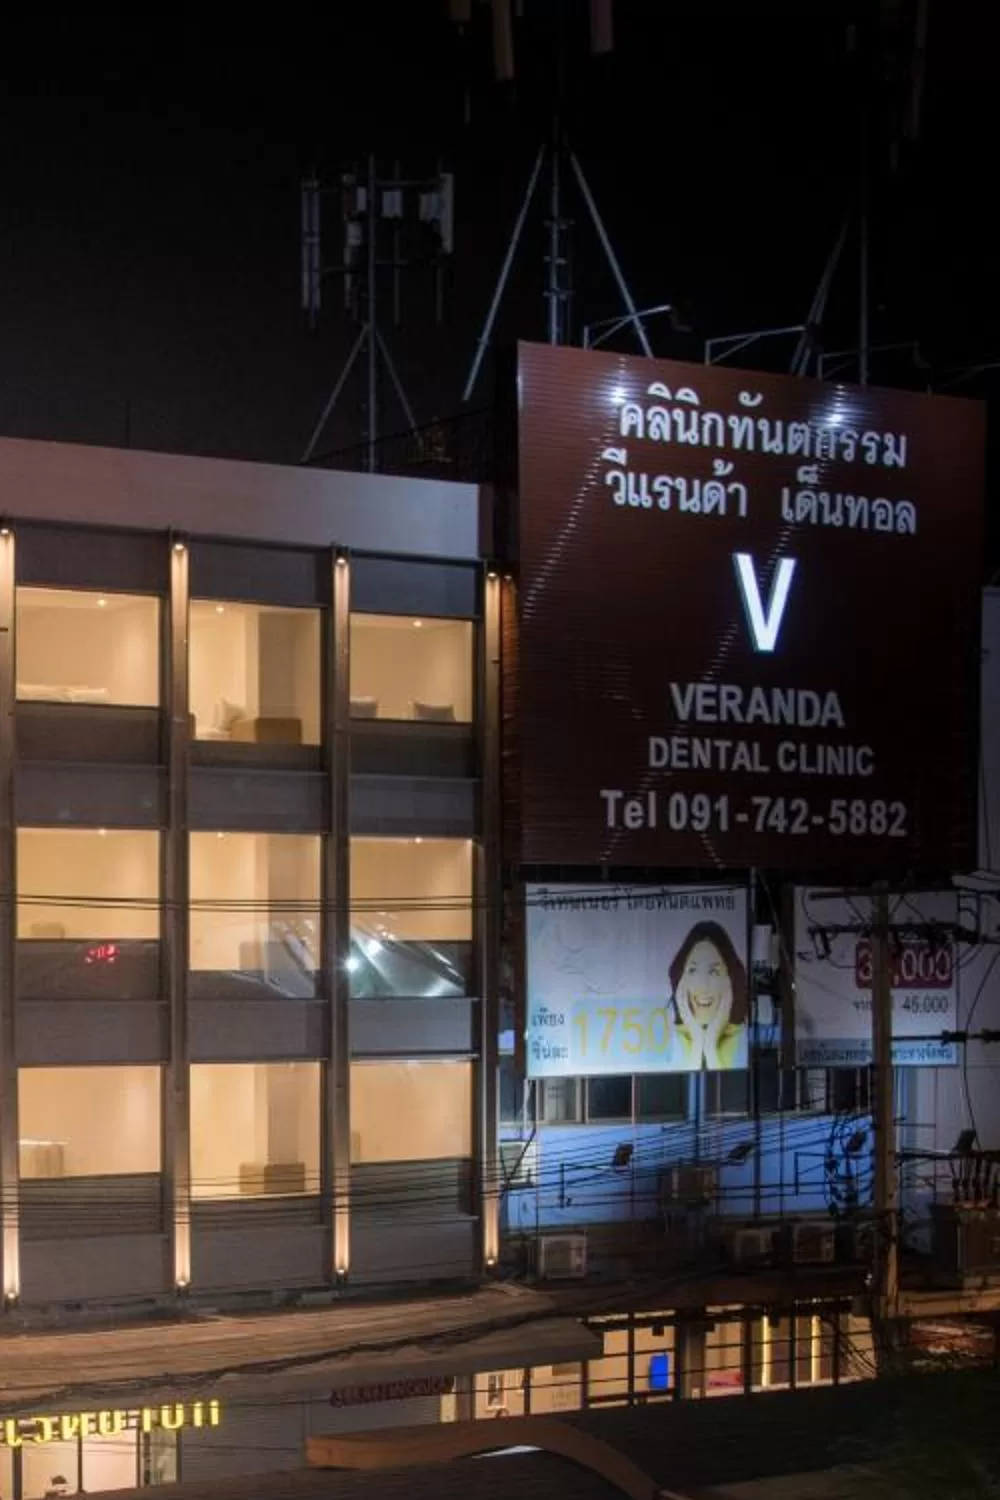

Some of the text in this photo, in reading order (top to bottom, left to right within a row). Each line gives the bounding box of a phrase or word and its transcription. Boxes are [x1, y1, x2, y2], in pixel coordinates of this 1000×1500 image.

[619, 382, 907, 468] คลินิกทันตกรรม
[601, 447, 917, 535] วีแรนด้า เด็นทอล
[732, 551, 797, 652] V
[669, 682, 846, 728] VERANDA
[648, 736, 875, 776] DENTAL CLINIC
[600, 788, 908, 838] Tel 091-742-5882
[572, 1007, 671, 1058] 1750
